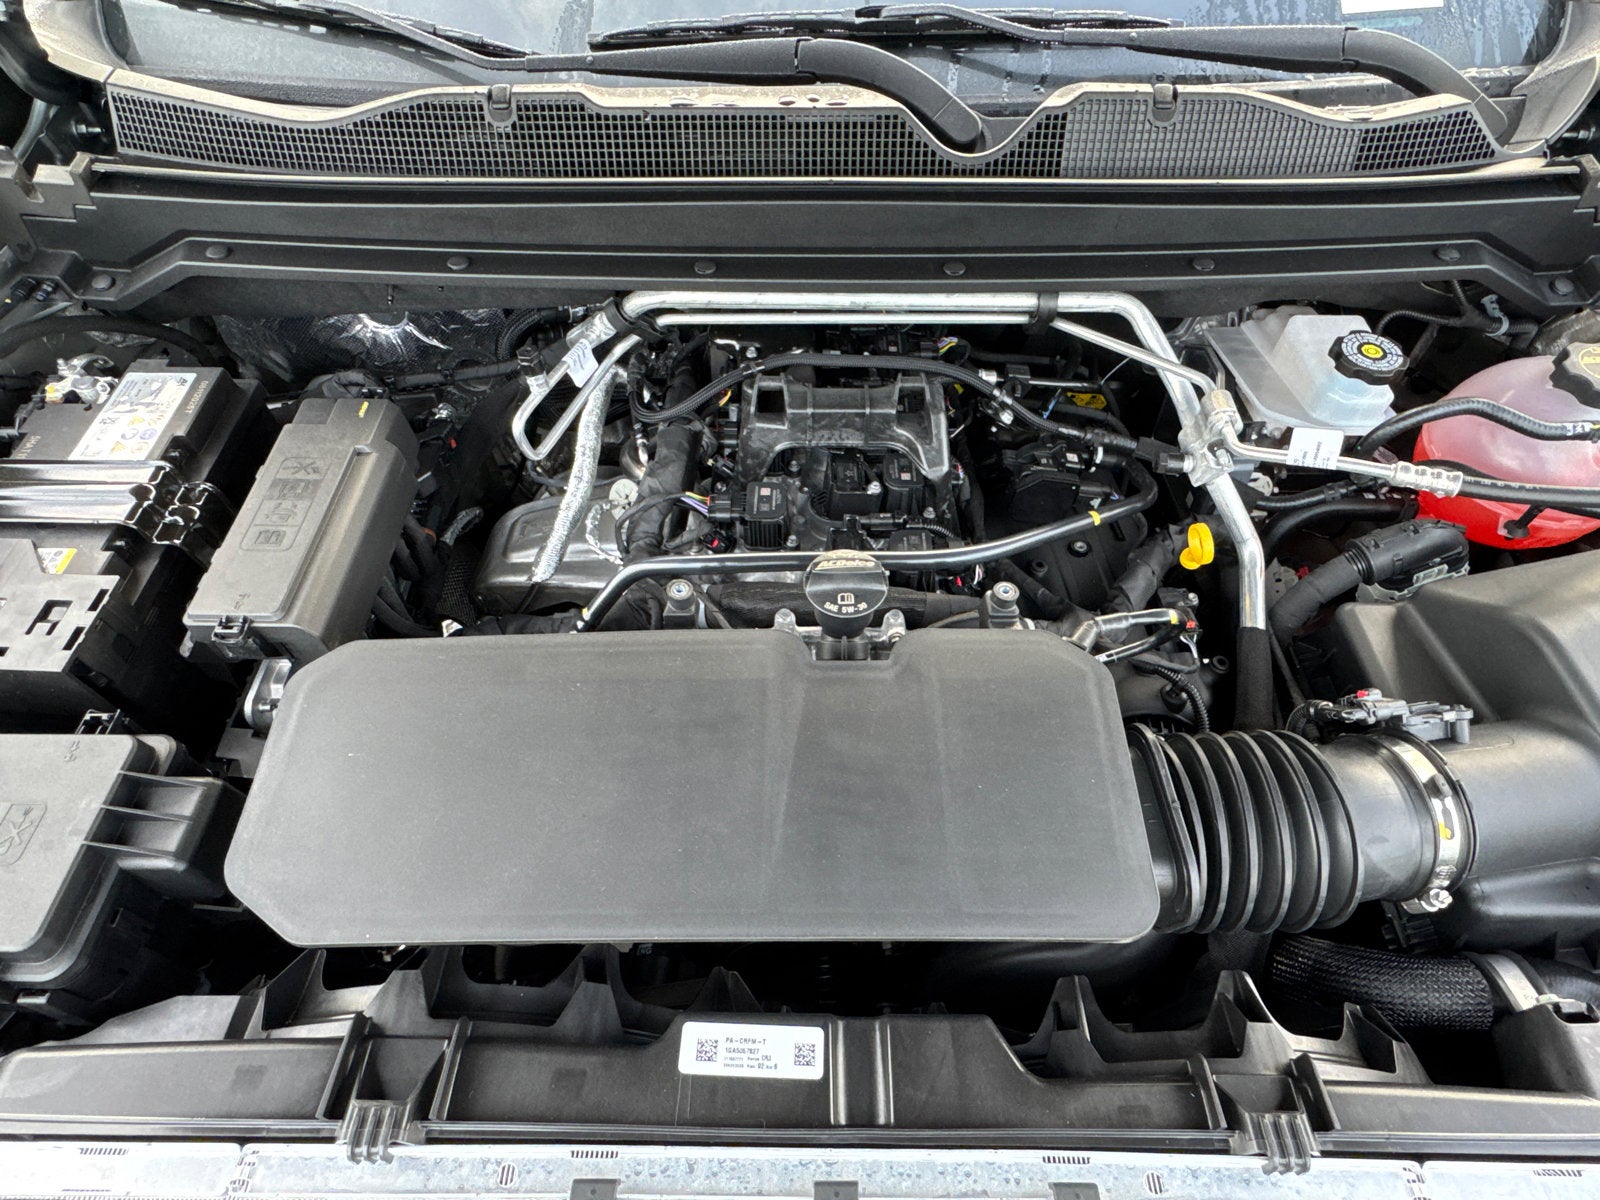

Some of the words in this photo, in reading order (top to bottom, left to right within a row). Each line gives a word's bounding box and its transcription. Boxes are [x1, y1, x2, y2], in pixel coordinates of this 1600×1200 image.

[814, 560, 875, 570] ACDelco
[824, 602, 839, 612] SAE
[842, 602, 868, 614] 5W-30
